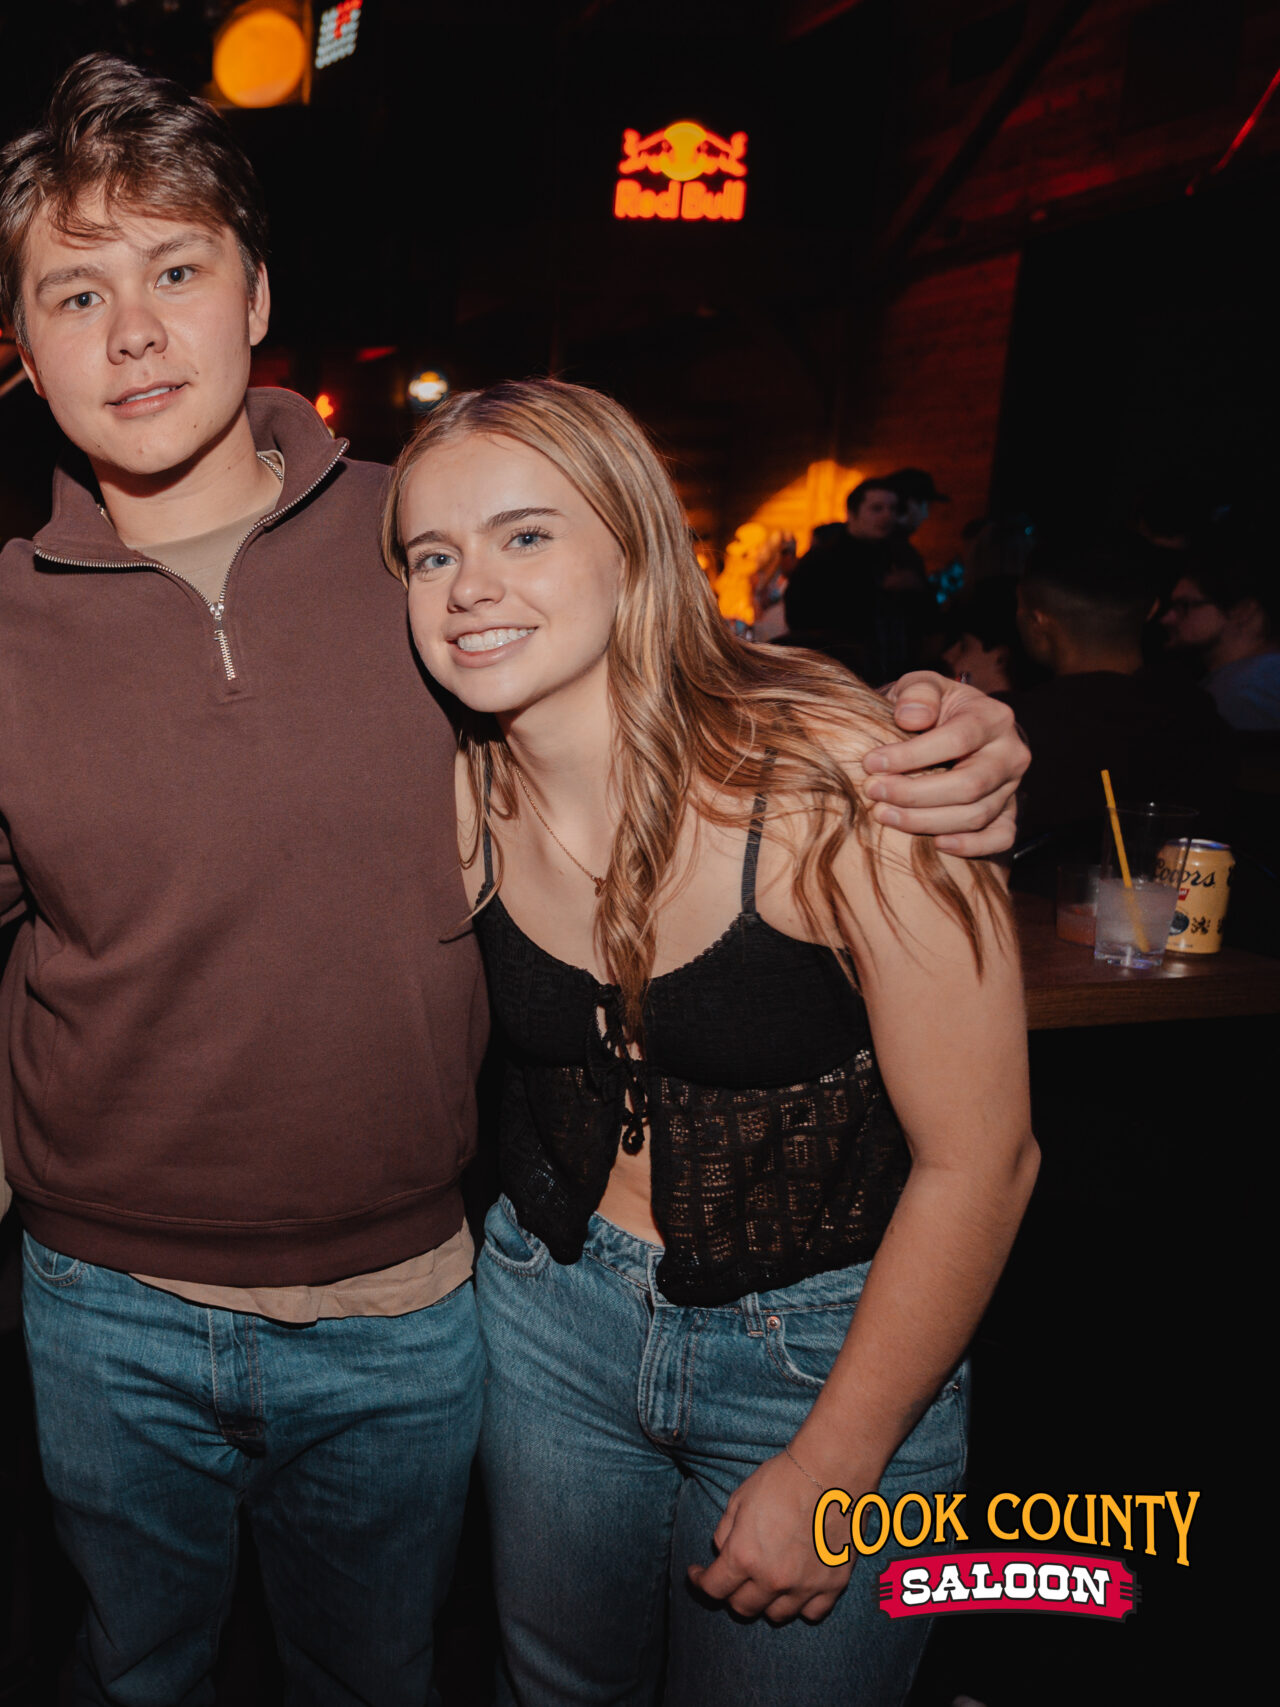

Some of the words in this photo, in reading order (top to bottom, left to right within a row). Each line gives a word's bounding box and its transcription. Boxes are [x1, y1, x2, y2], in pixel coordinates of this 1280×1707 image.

[614, 179, 681, 219] Red
[681, 180, 747, 221] Bull
[1153, 858, 1216, 887] Coors
